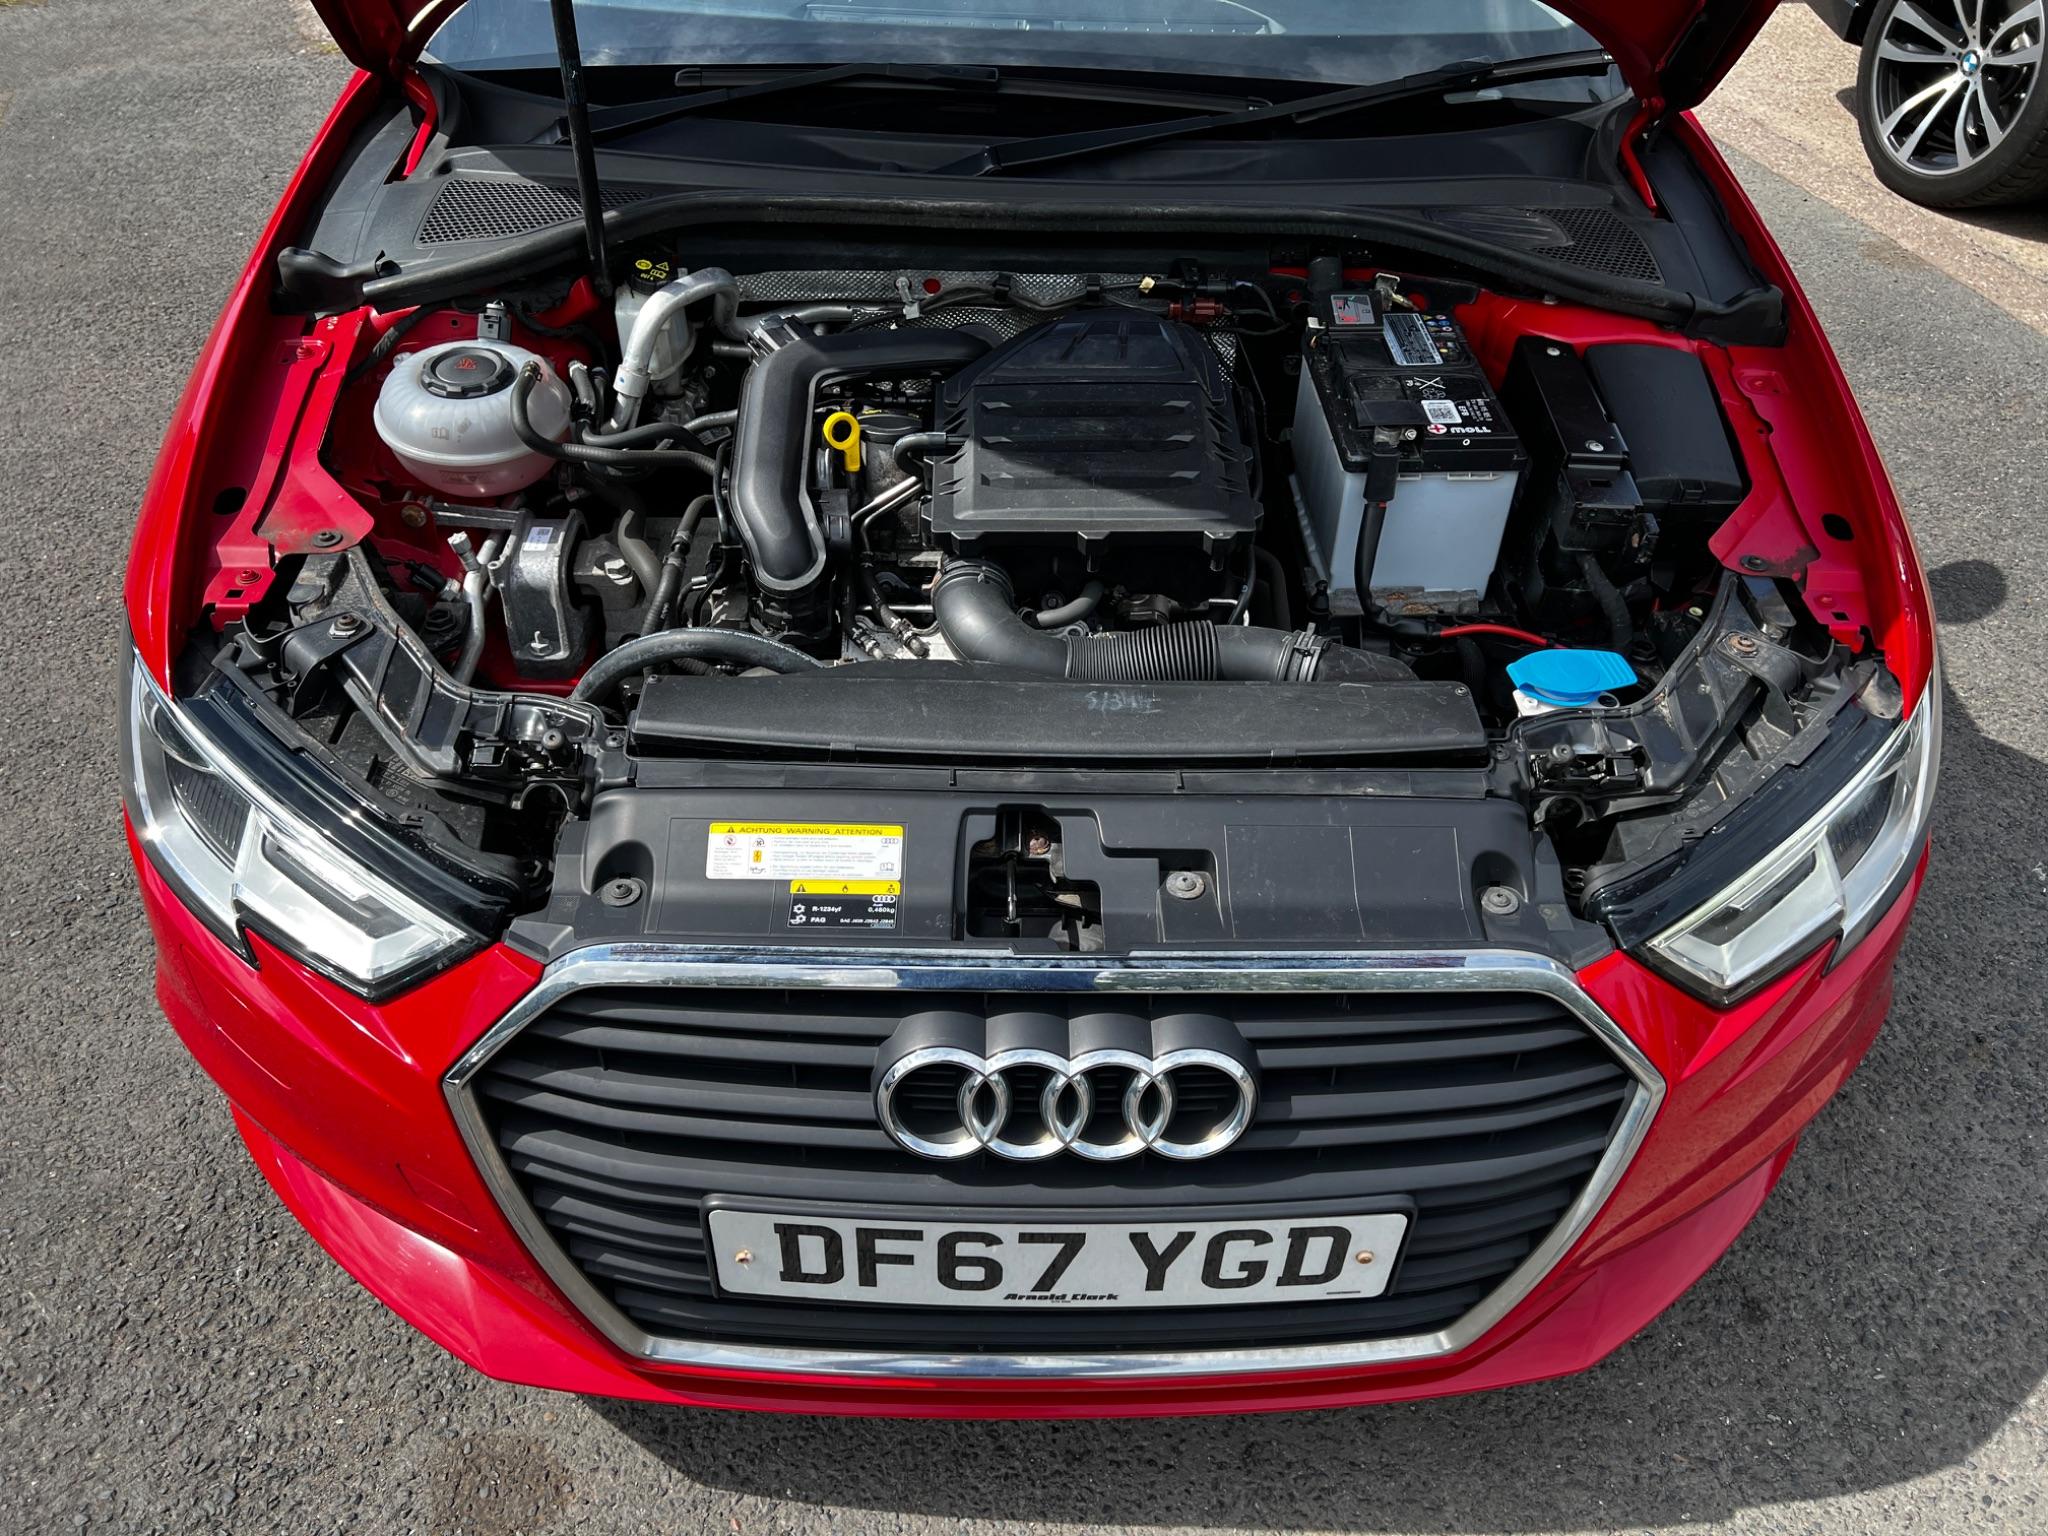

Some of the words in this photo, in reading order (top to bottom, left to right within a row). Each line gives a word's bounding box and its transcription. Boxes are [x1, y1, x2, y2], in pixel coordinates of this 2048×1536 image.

[739, 826, 783, 835] ACHTUNG
[786, 827, 830, 836] WARNING
[834, 828, 884, 836] ATTENTION
[810, 916, 827, 924] PAG
[773, 1222, 1087, 1292] DF67
[1129, 1225, 1353, 1293] YGD
[1003, 1293, 1067, 1301] Arnold
[1071, 1293, 1119, 1301] Clark
